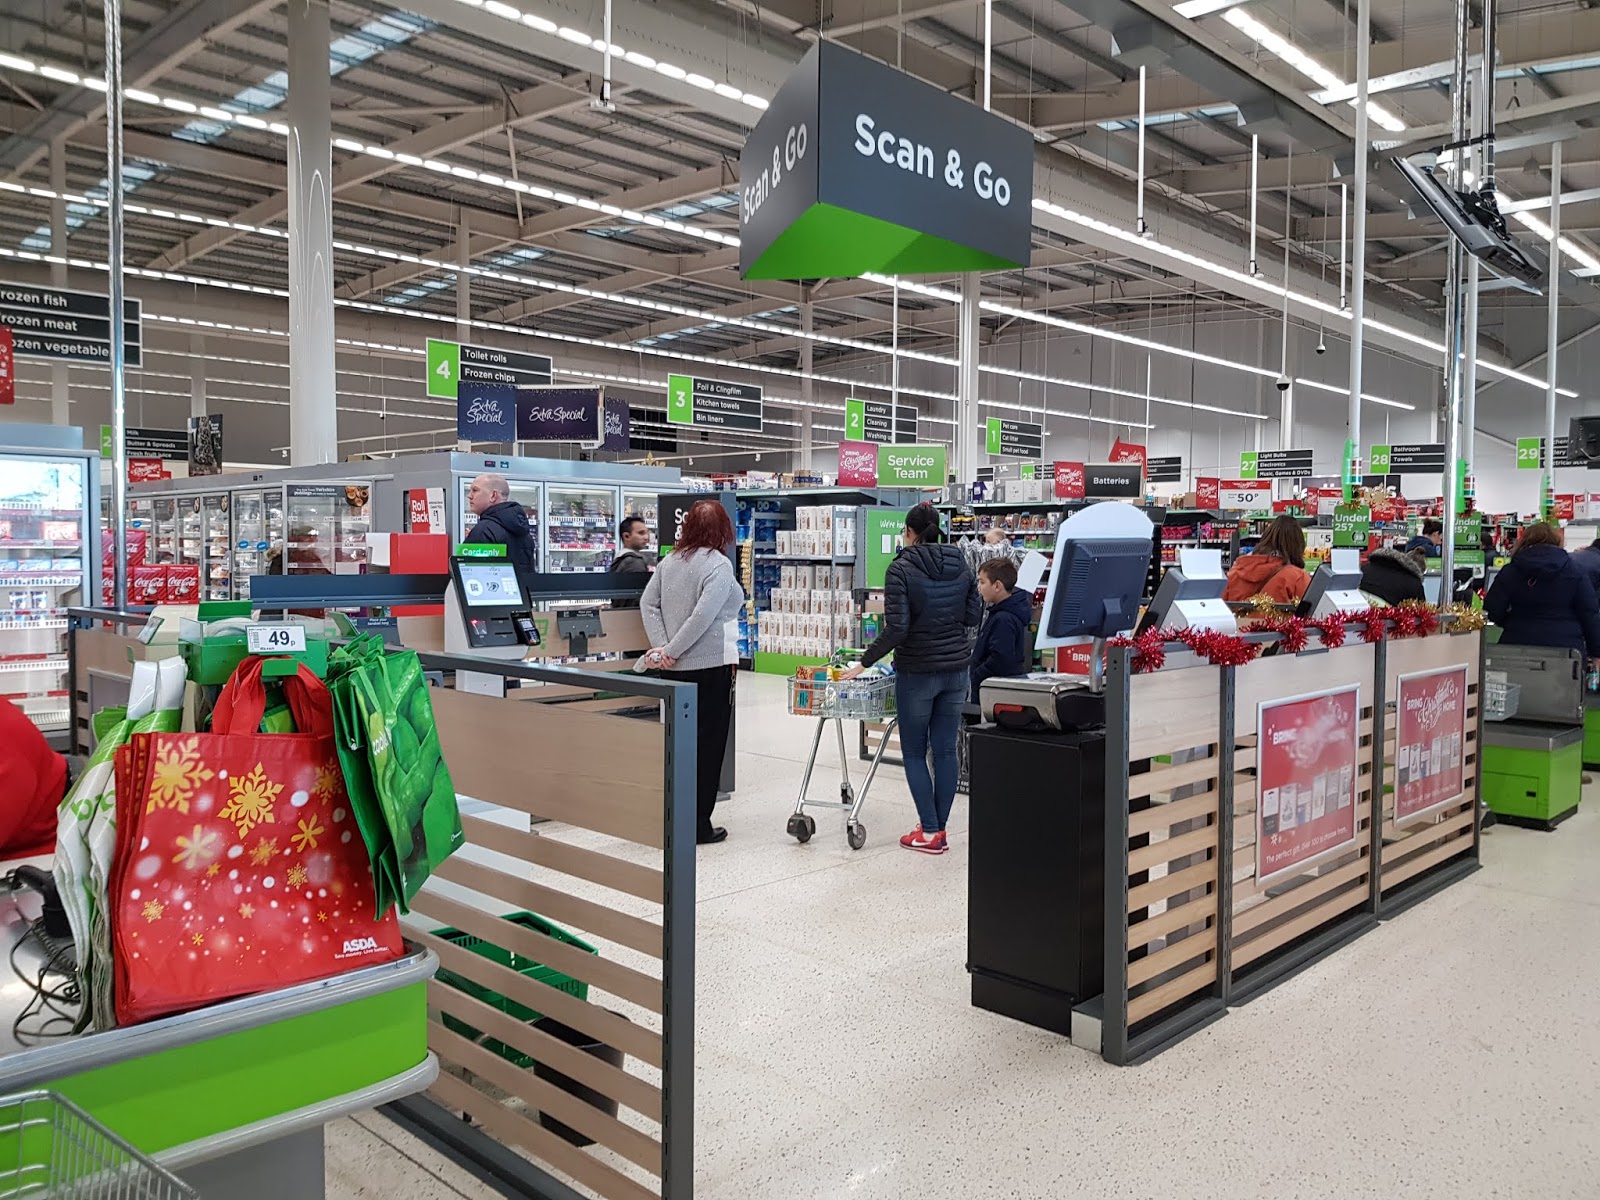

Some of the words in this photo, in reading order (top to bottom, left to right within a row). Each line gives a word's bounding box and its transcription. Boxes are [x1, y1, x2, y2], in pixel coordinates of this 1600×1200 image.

[854, 113, 935, 179] Scan
[944, 149, 964, 190] &
[973, 161, 1011, 207] Go
[743, 168, 769, 225] Scan
[771, 145, 782, 189] &
[785, 122, 808, 172] Go
[0, 289, 40, 304] rozen
[43, 294, 68, 307] fish
[0, 313, 41, 327] rozen
[44, 319, 78, 331] meat
[44, 342, 110, 357] vegetable
[465, 349, 488, 361] Toilet
[490, 353, 507, 363] rolls
[436, 359, 451, 379] 4
[464, 367, 493, 380] Frozen
[495, 372, 516, 383] chips
[696, 383, 709, 391] Foil
[715, 386, 742, 396] Clingfilm
[470, 397, 500, 412] Extra
[675, 390, 686, 408] 3
[696, 398, 720, 408] Kitchen
[720, 402, 740, 411] towels
[529, 406, 553, 422] Extra
[552, 406, 589, 425] Special
[866, 405, 887, 415] Laundry
[466, 408, 507, 426] Special
[696, 413, 707, 421] Bin
[707, 414, 724, 424] liners
[850, 413, 859, 428] 2
[866, 418, 888, 428] Cleaning
[866, 431, 887, 442] Washing
[991, 429, 997, 443] 1
[887, 454, 935, 467] Service
[1371, 454, 1389, 465] 28
[1518, 448, 1538, 460] 29
[1241, 460, 1257, 471] 27
[893, 467, 928, 479] Team
[1093, 476, 1130, 485] Batteries
[411, 499, 426, 512] Roll
[411, 511, 429, 523] Back
[674, 507, 689, 524] Sc
[1334, 513, 1368, 523] Under
[1334, 522, 1354, 532] 25?
[462, 548, 481, 556] Card
[482, 548, 500, 556] only
[1072, 652, 1091, 662] BRIN
[1265, 855, 1275, 865] The
[342, 936, 378, 954] ASDA
